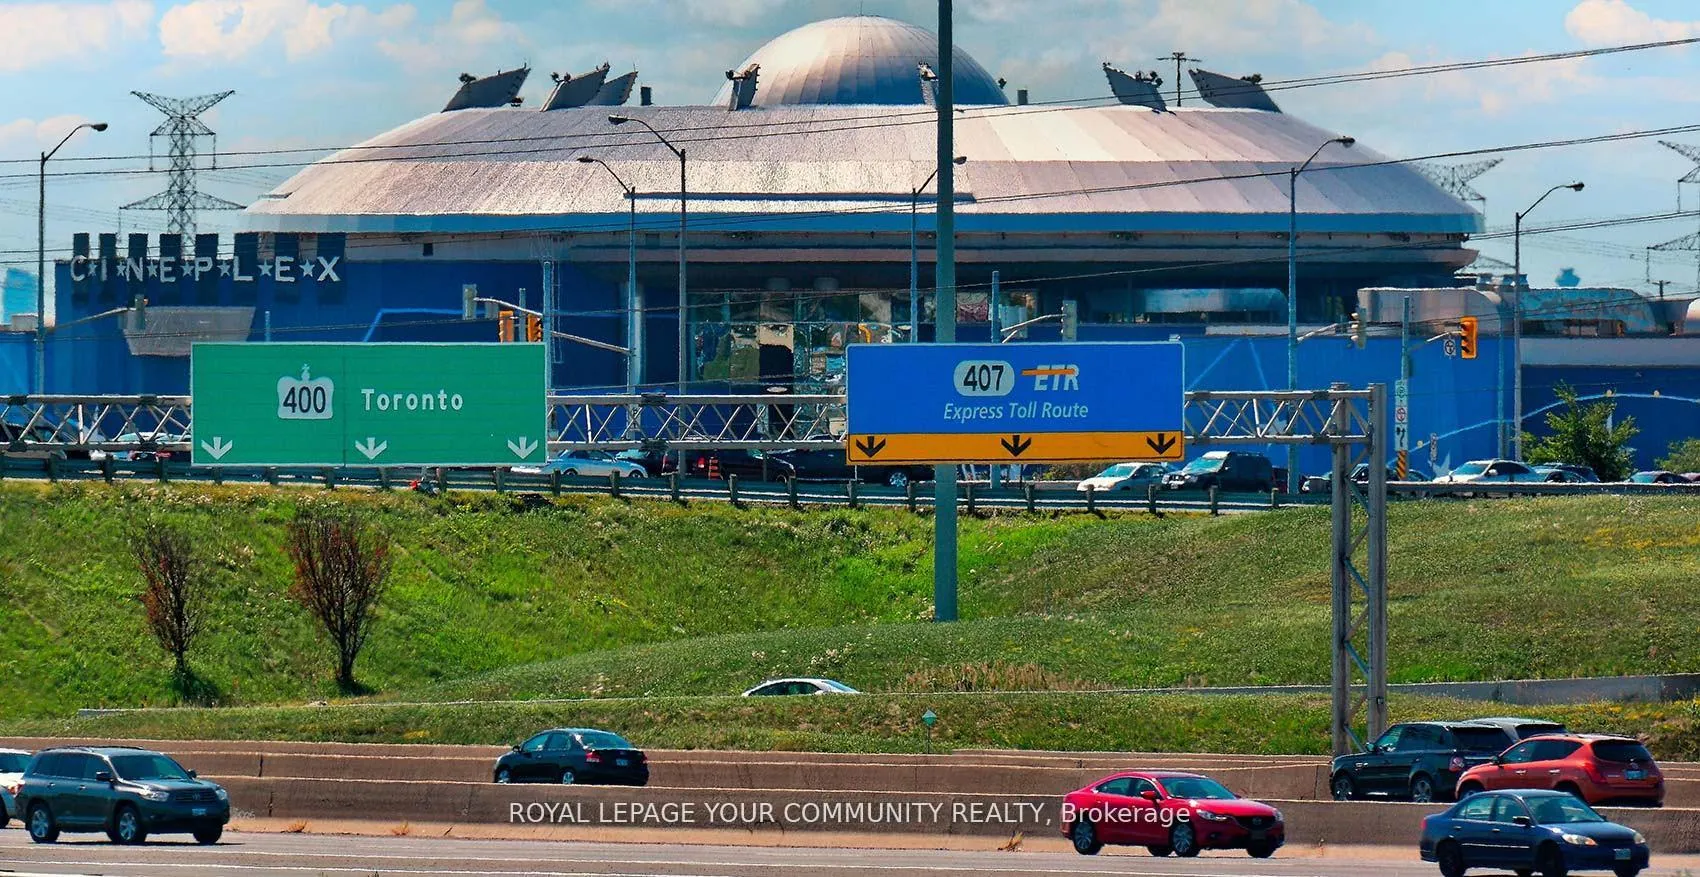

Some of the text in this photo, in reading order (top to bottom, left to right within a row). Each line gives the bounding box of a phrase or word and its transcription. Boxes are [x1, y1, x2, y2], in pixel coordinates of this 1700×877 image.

[963, 364, 1004, 391] 407
[1034, 364, 1080, 391] ETR
[283, 386, 326, 413] 400
[361, 388, 464, 411] Toronto
[943, 401, 1089, 424] Express Toll Route
